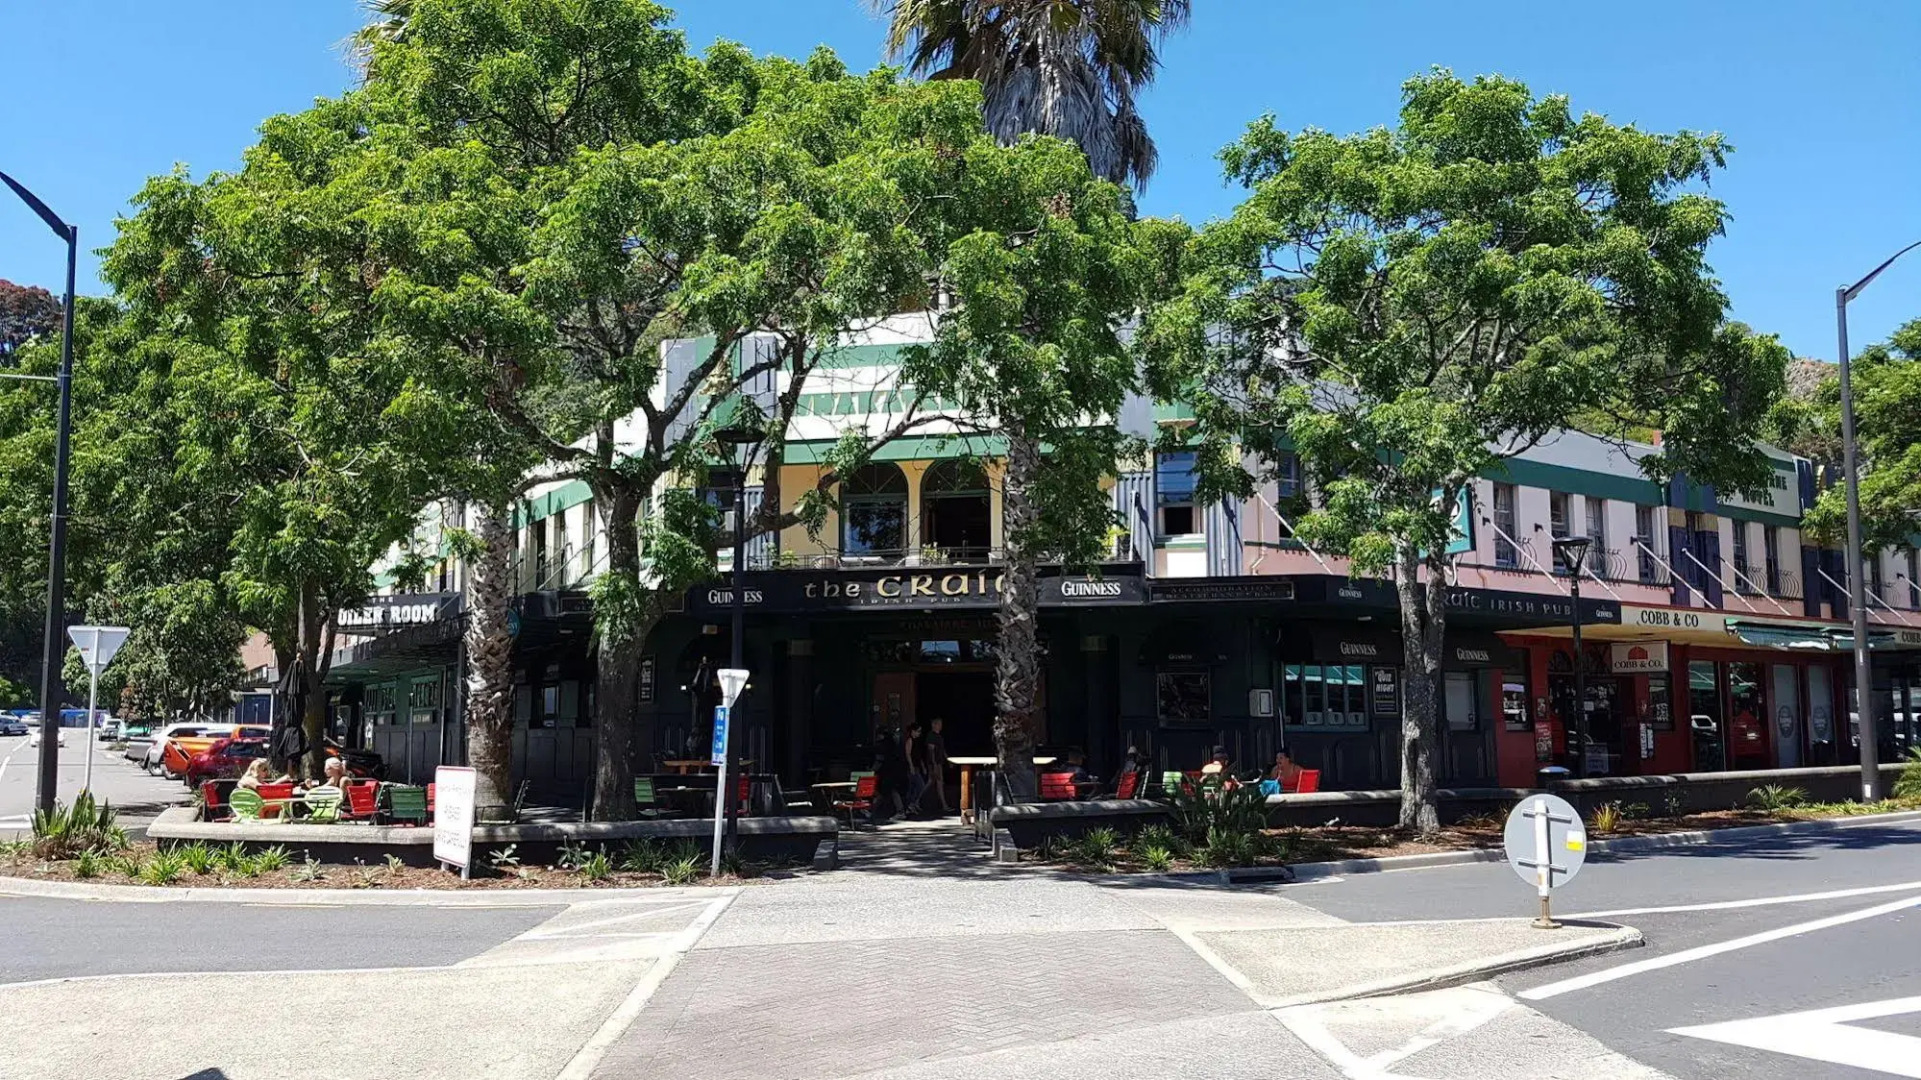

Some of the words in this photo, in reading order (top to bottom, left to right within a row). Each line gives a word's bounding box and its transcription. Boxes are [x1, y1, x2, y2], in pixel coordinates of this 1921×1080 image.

[804, 580, 861, 598] the
[1061, 581, 1121, 596] GUINNESS
[708, 589, 763, 604] GUINESS
[390, 602, 438, 623] ROOM
[1490, 599, 1534, 612] IRISH
[1543, 603, 1571, 615] PUB
[1641, 610, 1670, 625] COBB
[1673, 612, 1681, 626] &
[1684, 613, 1699, 627] CO
[1340, 641, 1377, 655] GUINNESS
[1614, 660, 1638, 669] COBB
[1640, 660, 1647, 668] &
[1648, 659, 1663, 668] CO.
